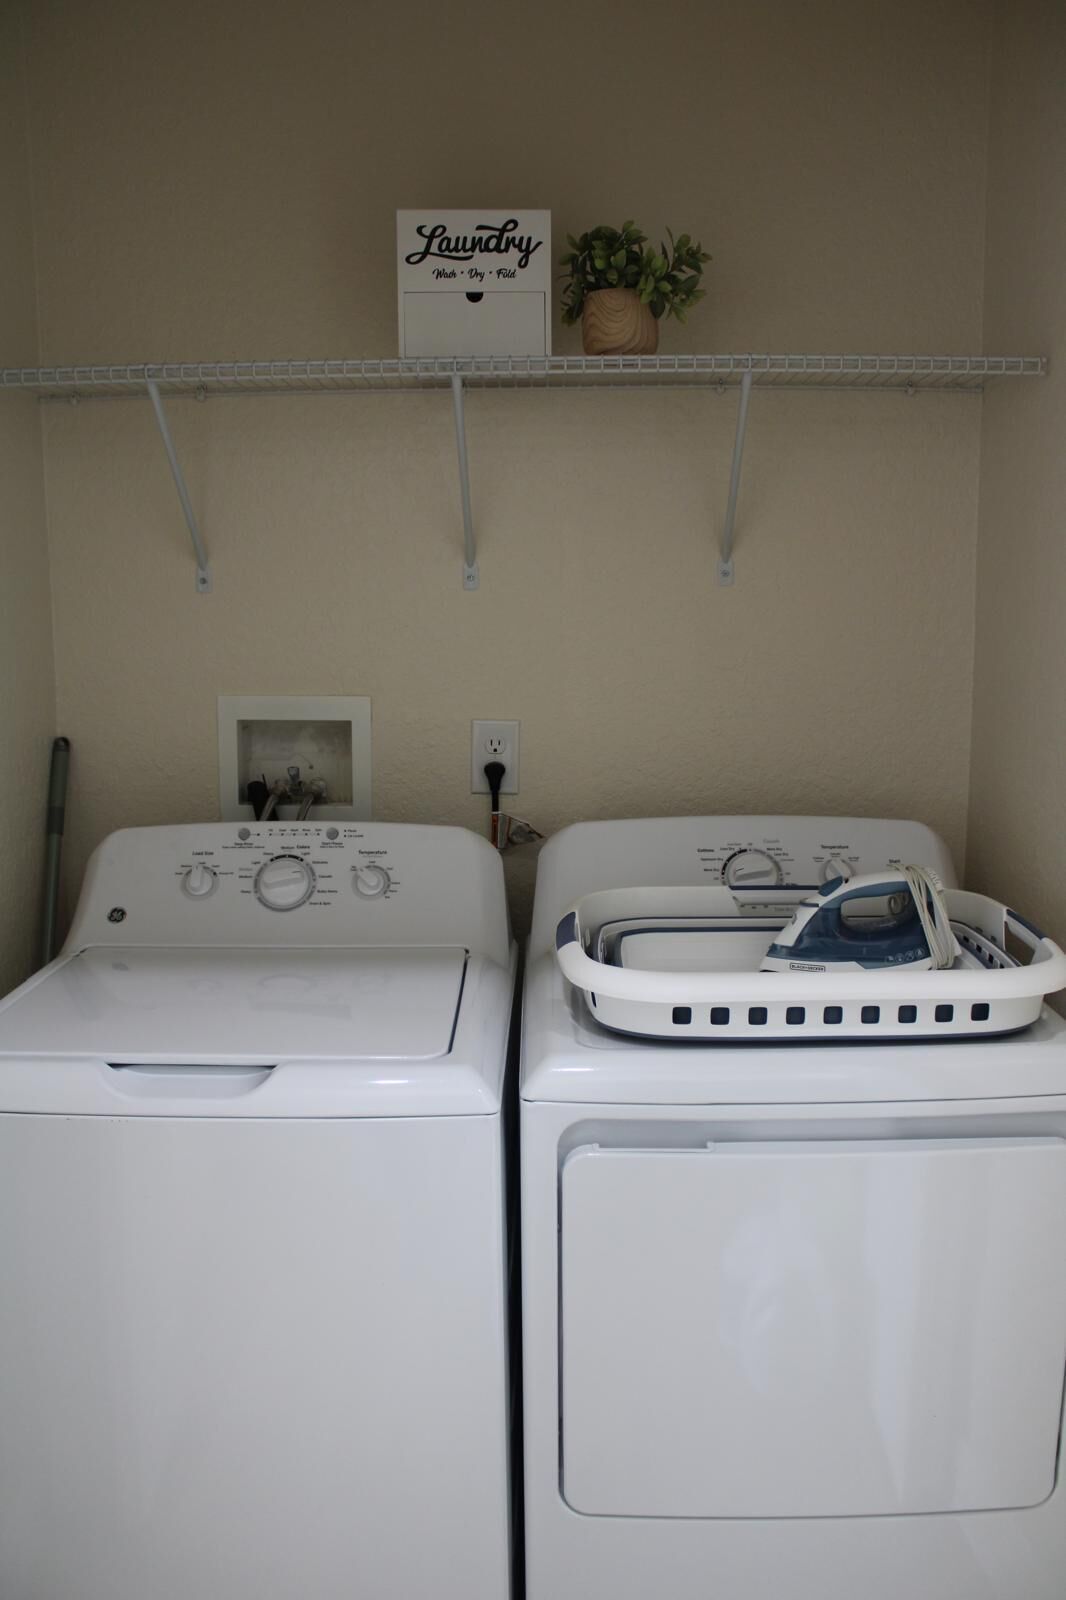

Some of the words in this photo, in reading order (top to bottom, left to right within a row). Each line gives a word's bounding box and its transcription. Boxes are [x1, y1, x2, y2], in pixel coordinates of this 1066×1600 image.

[405, 218, 544, 269] Laundry
[432, 267, 457, 280] Wash
[467, 267, 485, 282] Dry
[496, 267, 517, 280] Fold
